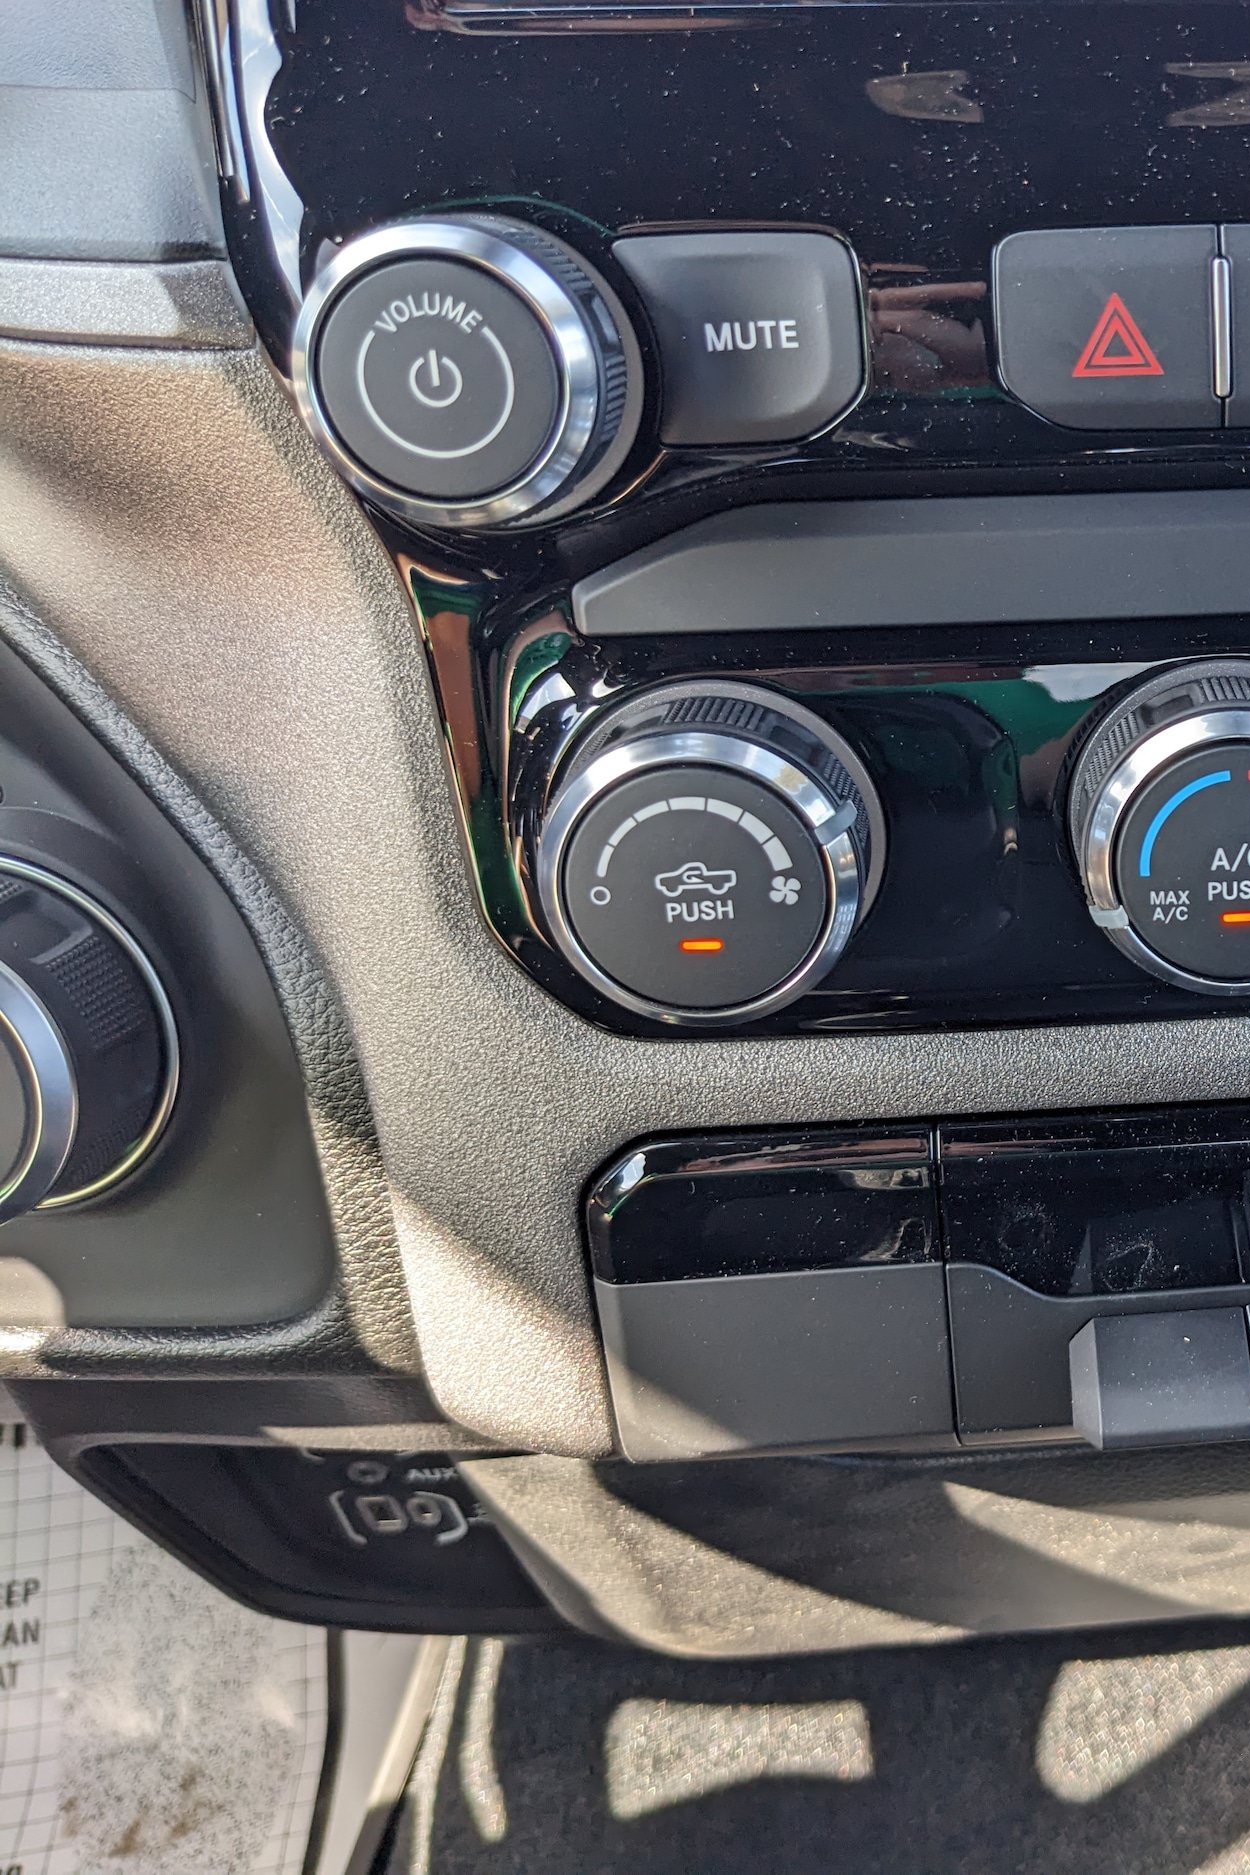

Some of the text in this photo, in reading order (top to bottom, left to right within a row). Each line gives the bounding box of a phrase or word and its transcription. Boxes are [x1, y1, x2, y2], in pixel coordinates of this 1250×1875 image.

[373, 293, 483, 335] VOLUME
[705, 319, 800, 352] MUTE
[1150, 890, 1190, 905] MAX
[666, 899, 734, 923] PUSH
[1152, 906, 1188, 924] A/C
